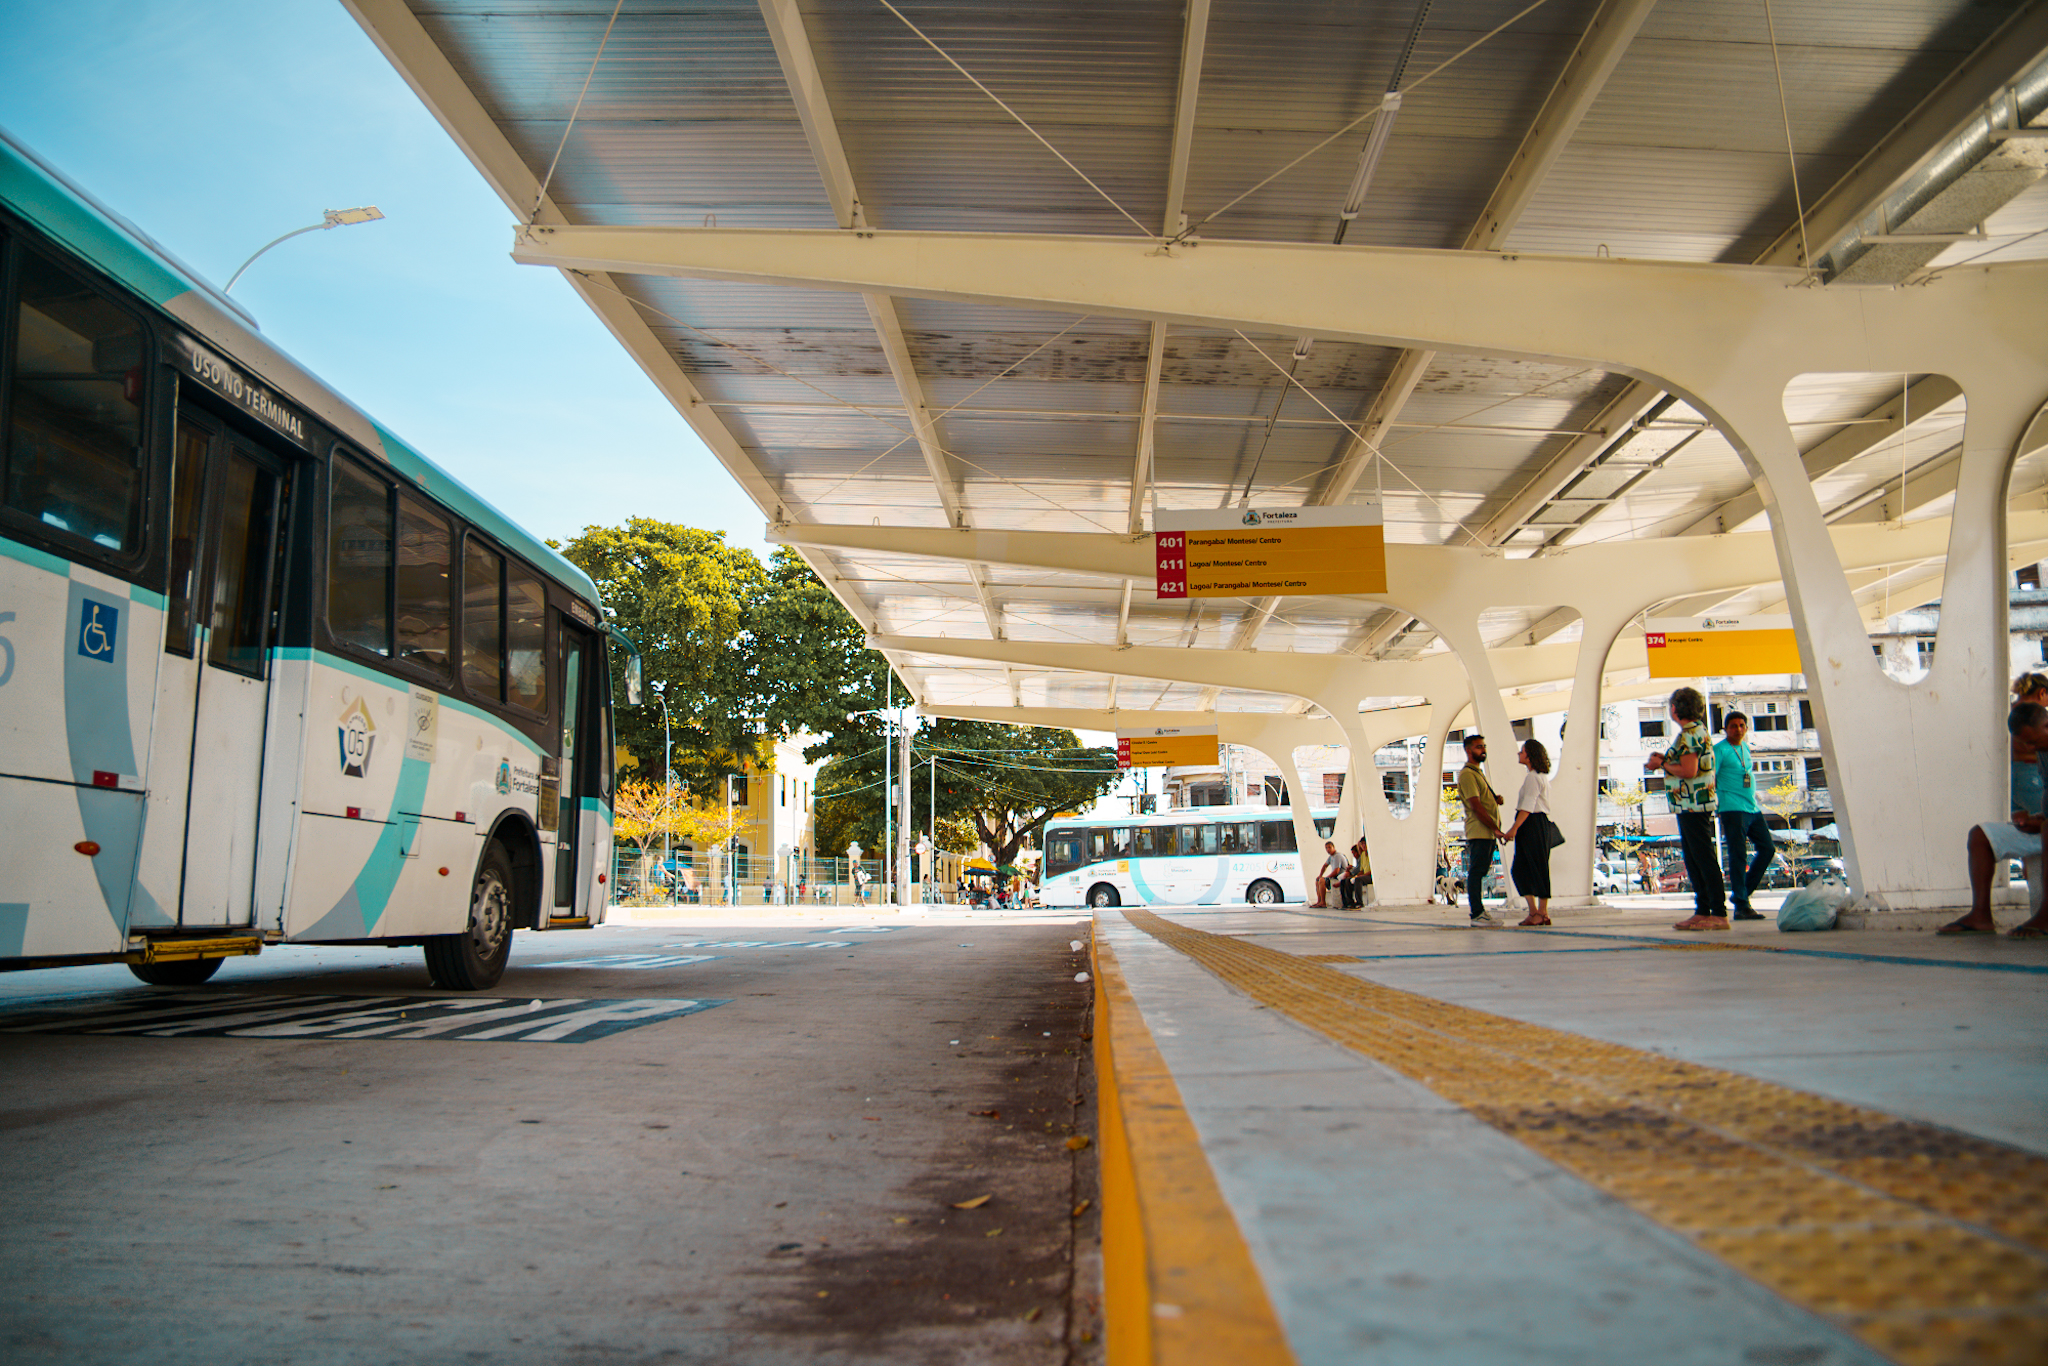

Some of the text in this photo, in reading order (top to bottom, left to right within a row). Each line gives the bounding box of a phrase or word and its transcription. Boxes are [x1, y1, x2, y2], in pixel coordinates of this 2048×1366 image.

[192, 350, 304, 440] USO NO TERMINAL
[1262, 511, 1298, 519] Fortaleza
[1159, 537, 1183, 548] 401
[1188, 538, 1226, 547] Parangaba/
[1227, 537, 1258, 545] Montese/
[1159, 559, 1184, 570] 411
[1189, 561, 1211, 569] Lagoa/
[1160, 582, 1185, 593] 421
[1190, 583, 1212, 591] Lagoa/
[1213, 581, 1251, 590] Parangaba/
[1647, 636, 1665, 645] 374
[347, 728, 364, 757] 05
[1232, 863, 1260, 872] 42705
[524, 953, 718, 970] 20
